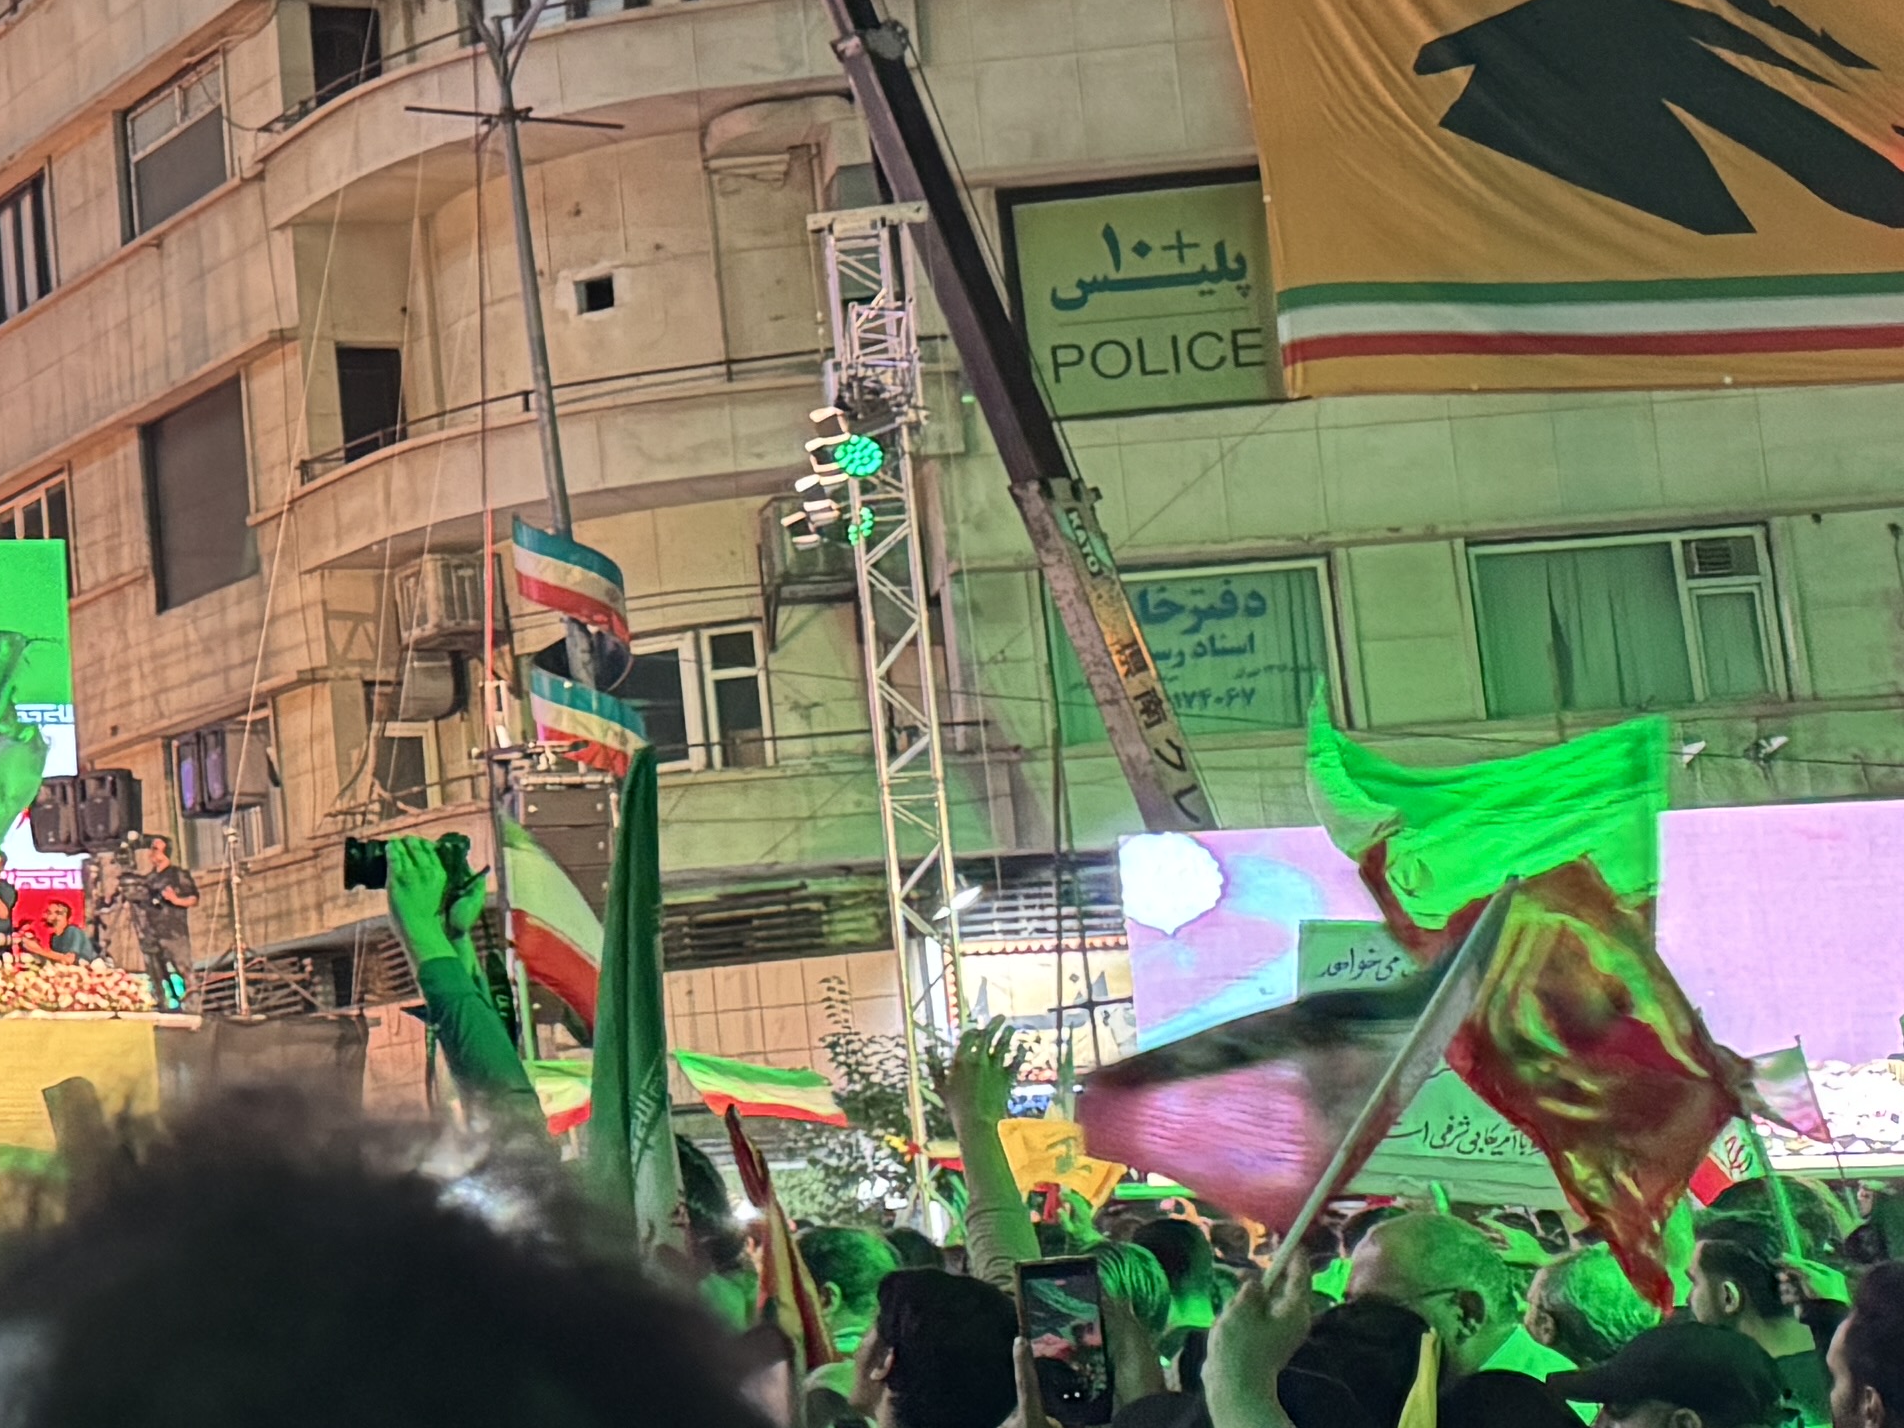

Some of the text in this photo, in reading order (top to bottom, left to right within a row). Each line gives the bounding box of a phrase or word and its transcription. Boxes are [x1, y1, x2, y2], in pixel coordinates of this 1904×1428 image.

[1050, 239, 1252, 311] پلیس
[1050, 327, 1267, 384] POLICE
[1067, 509, 1101, 572] KATO
[1135, 579, 1267, 635] دفترخا
[1192, 631, 1255, 659] اسناد
